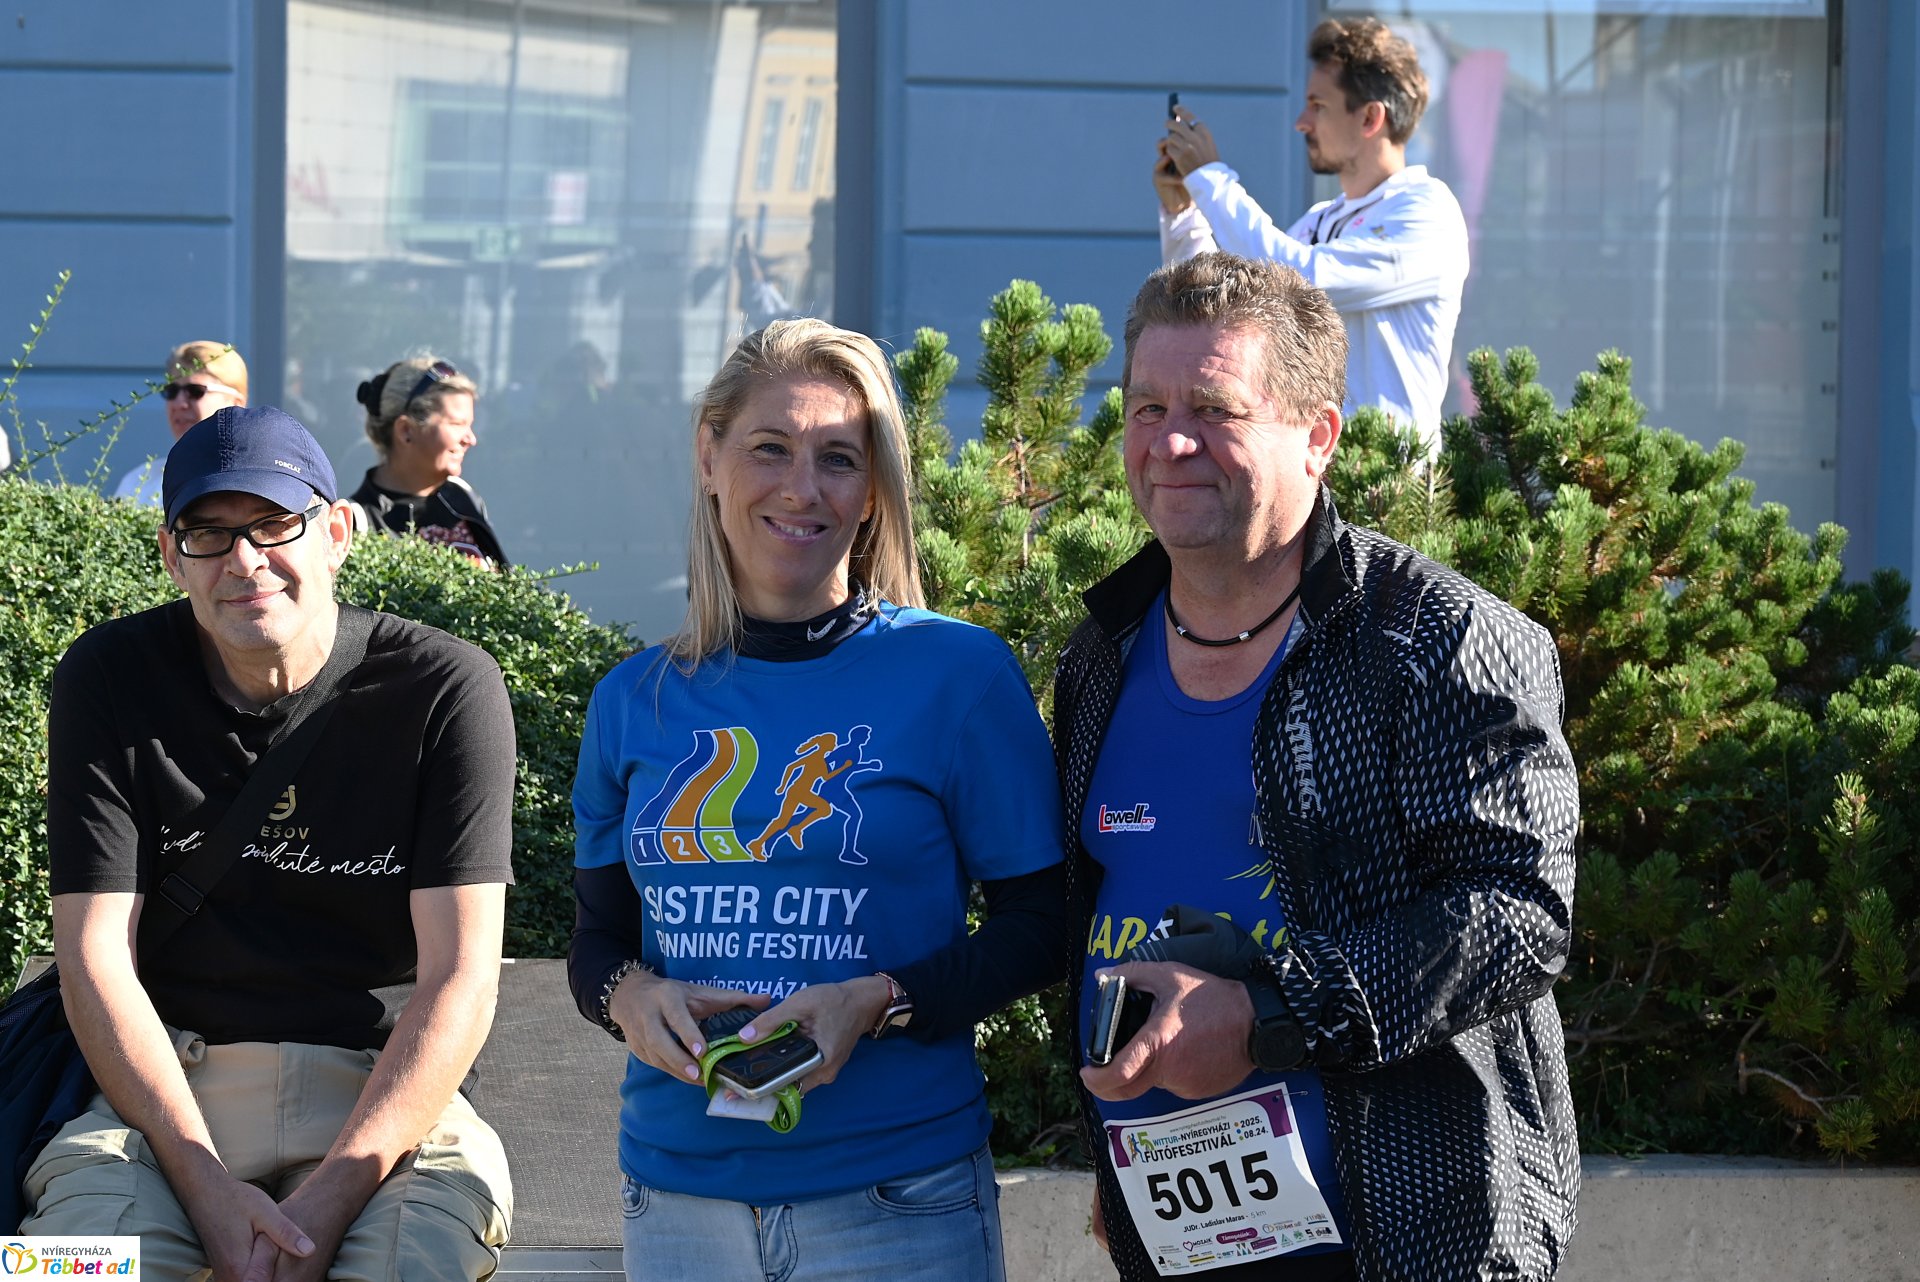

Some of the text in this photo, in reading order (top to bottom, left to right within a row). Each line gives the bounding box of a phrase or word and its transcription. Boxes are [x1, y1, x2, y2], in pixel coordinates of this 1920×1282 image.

[274, 459, 301, 473] FORCLAZ
[1099, 803, 1148, 832] Lowell
[260, 824, 310, 840] EŠOV
[638, 835, 732, 858] 1 2 3
[330, 845, 405, 875] mesto
[644, 885, 869, 926] SISTER CITY
[746, 932, 868, 960] FESTIVAL
[1152, 1121, 1231, 1146] WITTUR-NYÍREGYHÁZI
[1240, 1116, 1263, 1129] 2025.
[1244, 1126, 1269, 1139] 08.24.
[1143, 1132, 1237, 1163] FUTÓFESZTIVÁL
[1146, 1150, 1279, 1221] 5015
[1200, 1218, 1226, 1229] Ladislav
[1225, 1214, 1245, 1223] Maras
